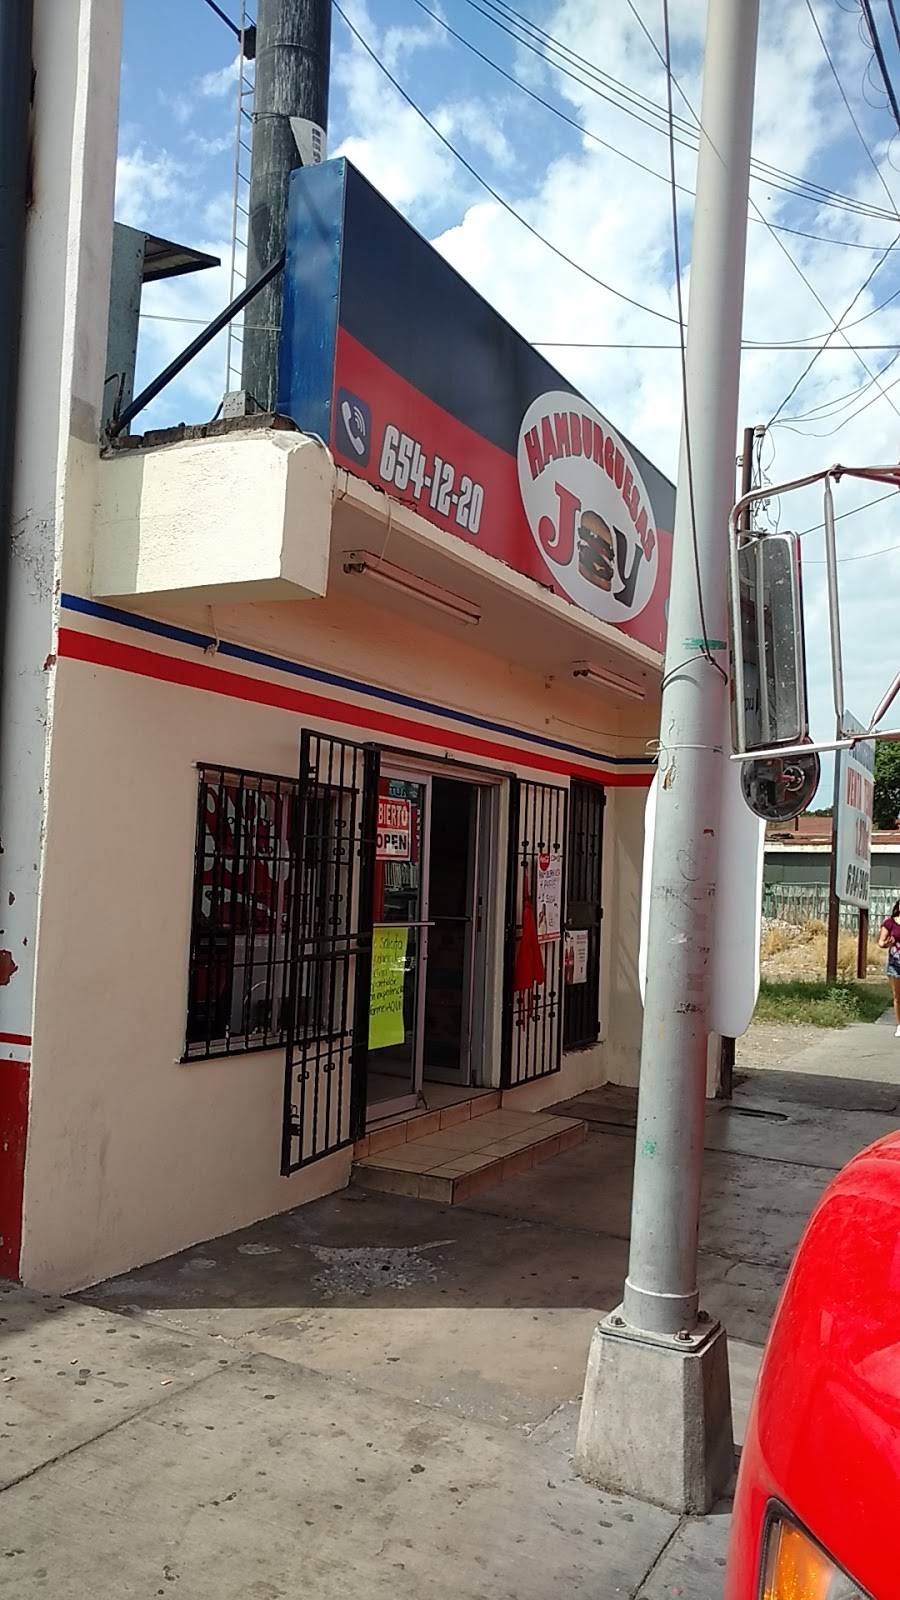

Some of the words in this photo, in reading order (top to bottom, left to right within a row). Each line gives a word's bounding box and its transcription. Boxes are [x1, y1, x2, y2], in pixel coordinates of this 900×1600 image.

[379, 424, 484, 535] 654-12-20
[523, 411, 656, 562] HAMBURGUESAS
[376, 833, 408, 851] OPEN
[378, 803, 409, 828] BIERTO
